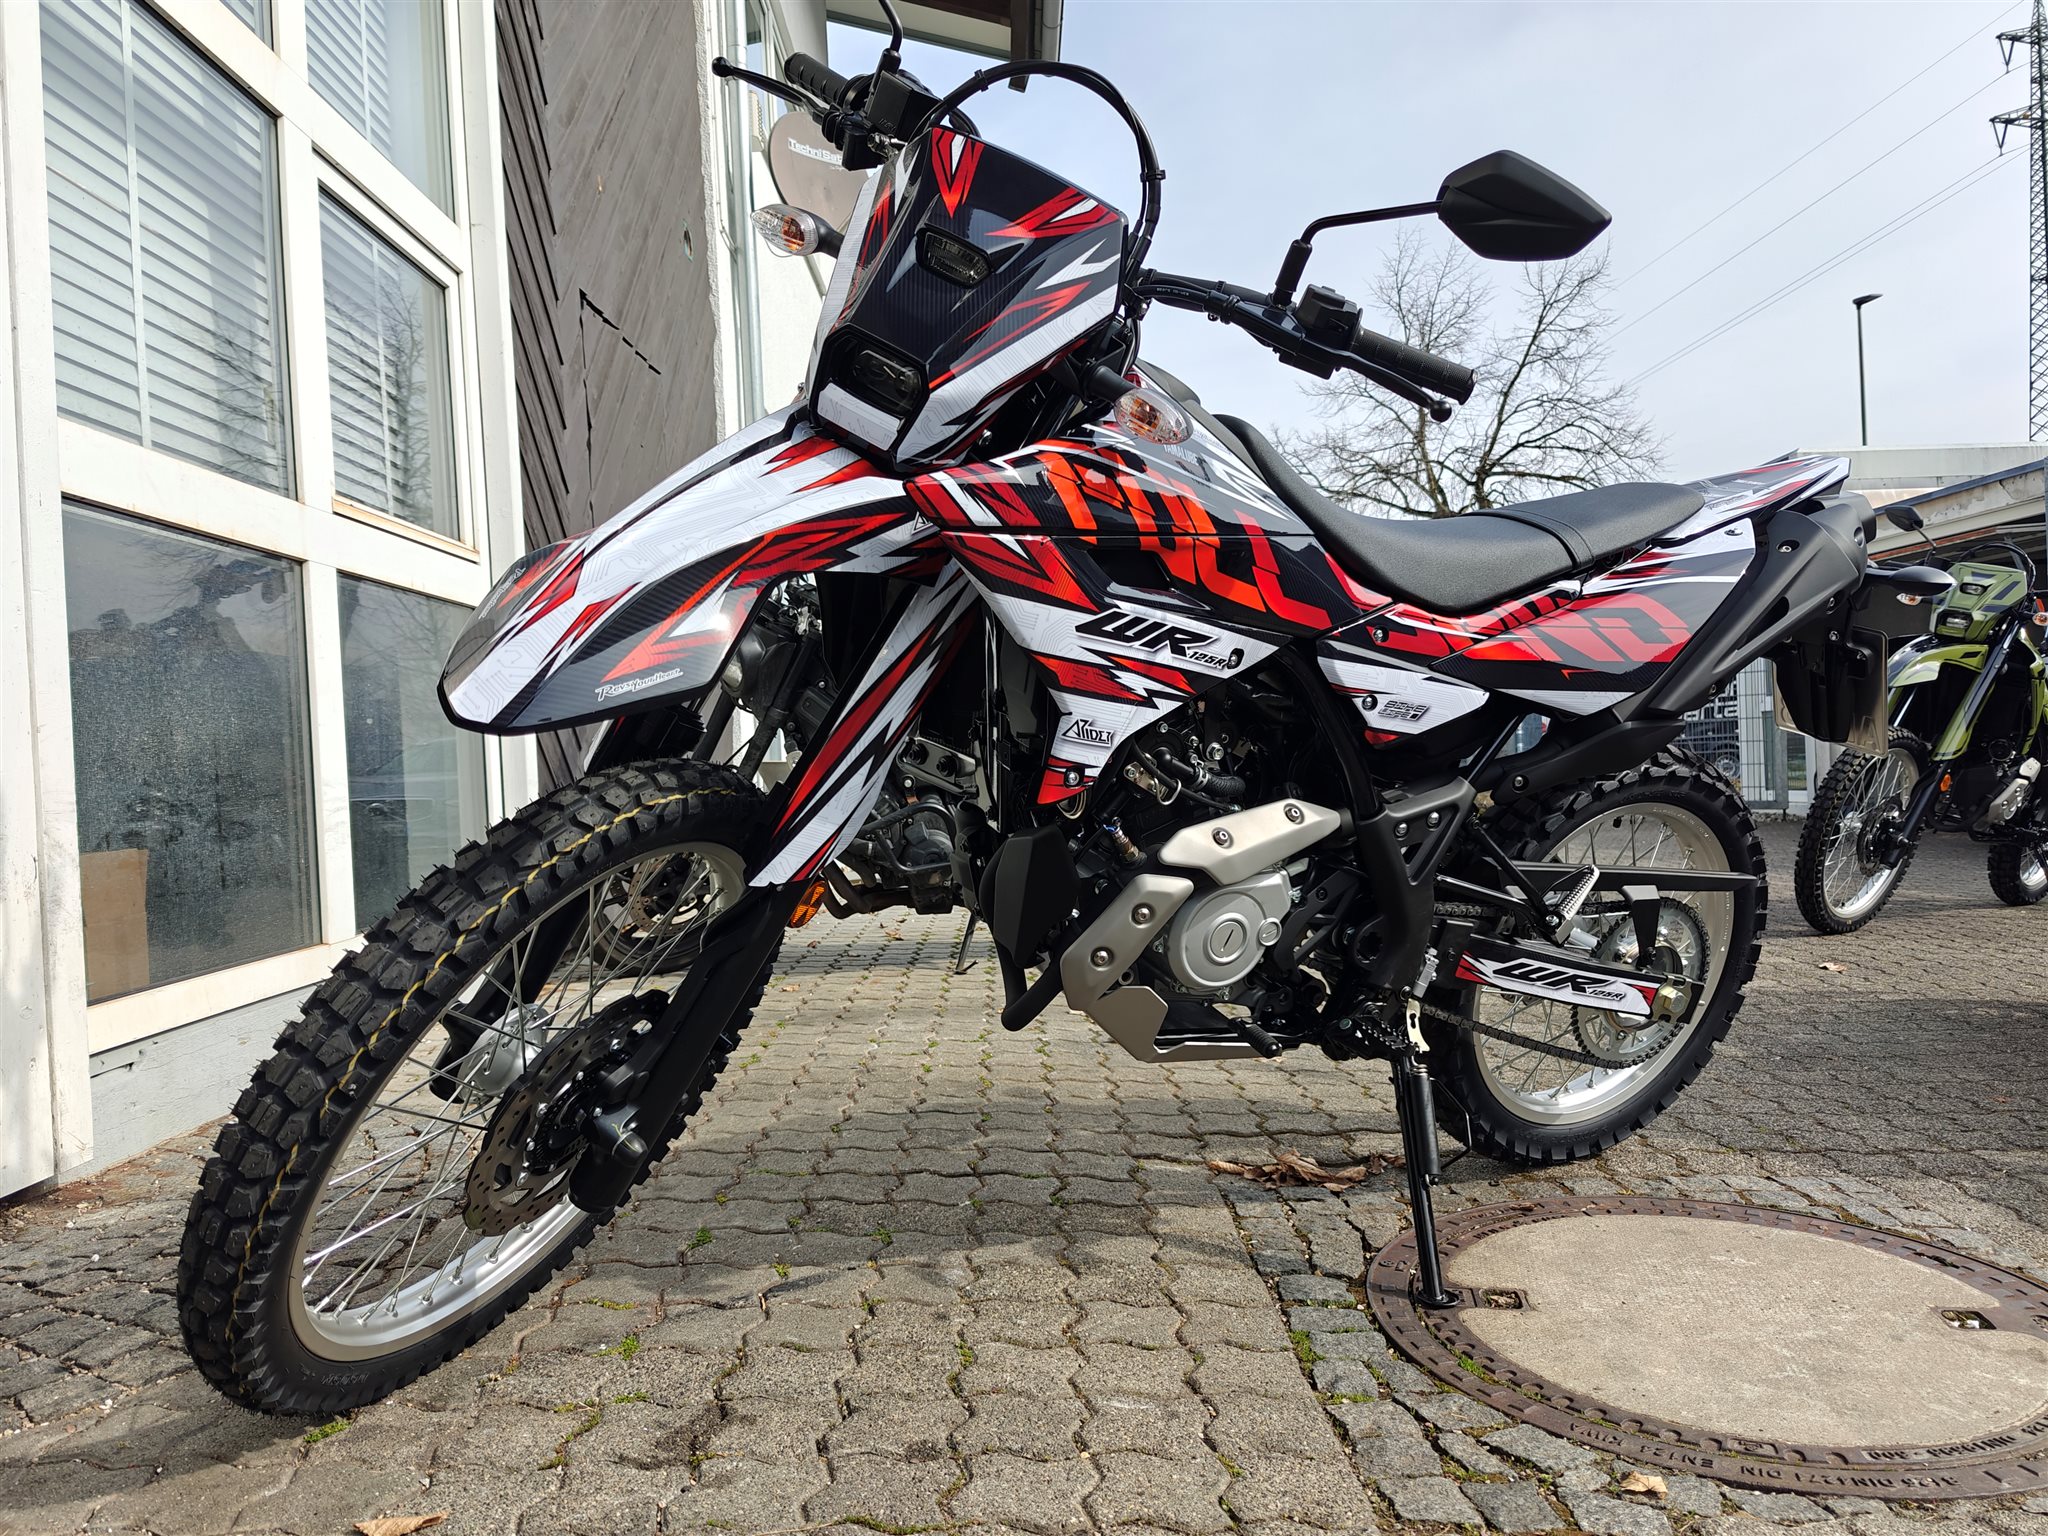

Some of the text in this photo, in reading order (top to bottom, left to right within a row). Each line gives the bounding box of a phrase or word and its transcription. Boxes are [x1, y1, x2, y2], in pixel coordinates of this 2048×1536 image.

[1075, 610, 1212, 657] WR
[1384, 700, 1427, 713] BIKE
[1493, 962, 1612, 993] WR
[1740, 1465, 1783, 1480] DIN
